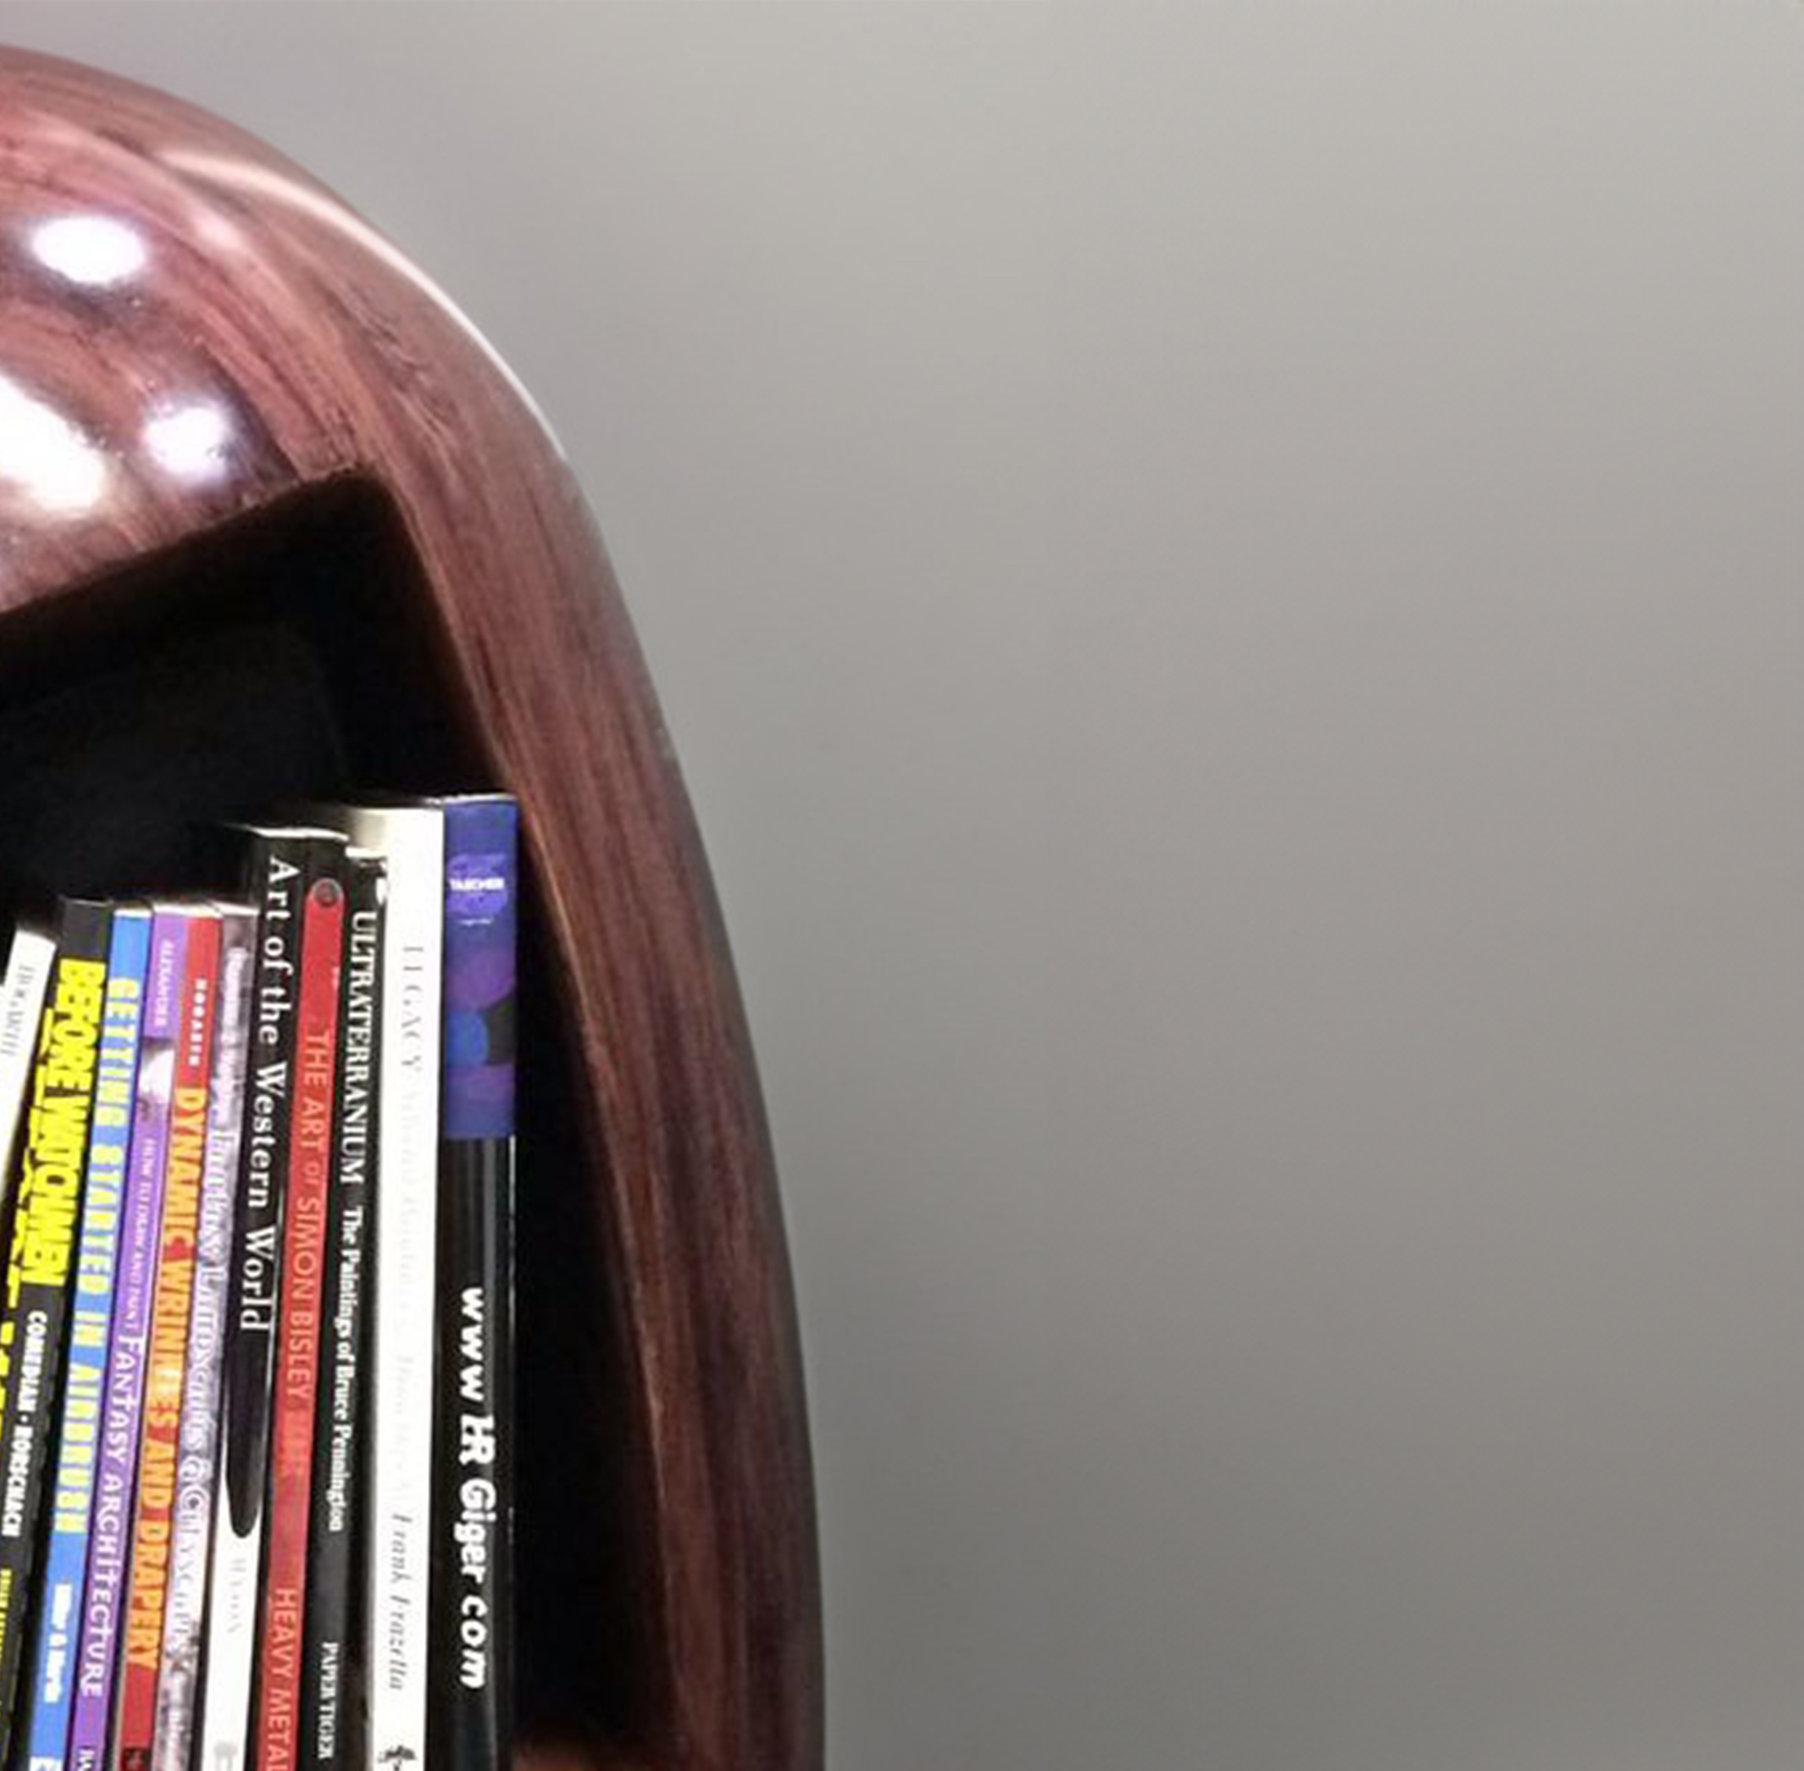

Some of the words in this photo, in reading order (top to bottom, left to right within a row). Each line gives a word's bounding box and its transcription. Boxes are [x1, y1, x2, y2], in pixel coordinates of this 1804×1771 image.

[265, 855, 299, 922] Art
[151, 939, 174, 1027] ALEXANDER
[262, 935, 295, 975] of
[43, 957, 106, 1091] BEFORE
[93, 976, 140, 1127] GETTING
[187, 978, 206, 1065] HOGARTH
[258, 985, 293, 1046] the
[304, 1029, 329, 1085] THE
[340, 910, 376, 1183] ULTRATERRANIUM
[162, 1085, 207, 1248] DYNAMIC
[247, 1059, 287, 1209] Western
[300, 1096, 325, 1151] ART
[19, 1091, 89, 1287] WATCHMEN
[78, 1143, 124, 1294] STARTED
[341, 1205, 362, 1238] The
[239, 1222, 278, 1332] World
[292, 1196, 320, 1299] SIMON
[334, 1242, 360, 1338] Paintings
[15, 1310, 49, 1413] COMEDIAN
[72, 1310, 108, 1347] IN
[286, 1310, 313, 1400] BISLEY
[335, 1341, 356, 1360] of
[459, 1286, 485, 1400] www
[332, 1365, 354, 1420] Bruce
[1, 1424, 33, 1537] RORSCHACH
[53, 1363, 102, 1533] AIRBRUSH
[140, 1438, 177, 1510] AND
[324, 1424, 351, 1532] Pennington
[388, 1513, 413, 1584] Frank
[453, 1478, 495, 1582] Giger
[127, 1519, 170, 1670] DRAPERY
[271, 1588, 297, 1676] HEAVY
[386, 1593, 413, 1690] Frazetta
[459, 1594, 490, 1688] com
[319, 1642, 338, 1699] PAPER
[317, 1701, 336, 1760] TIGER
